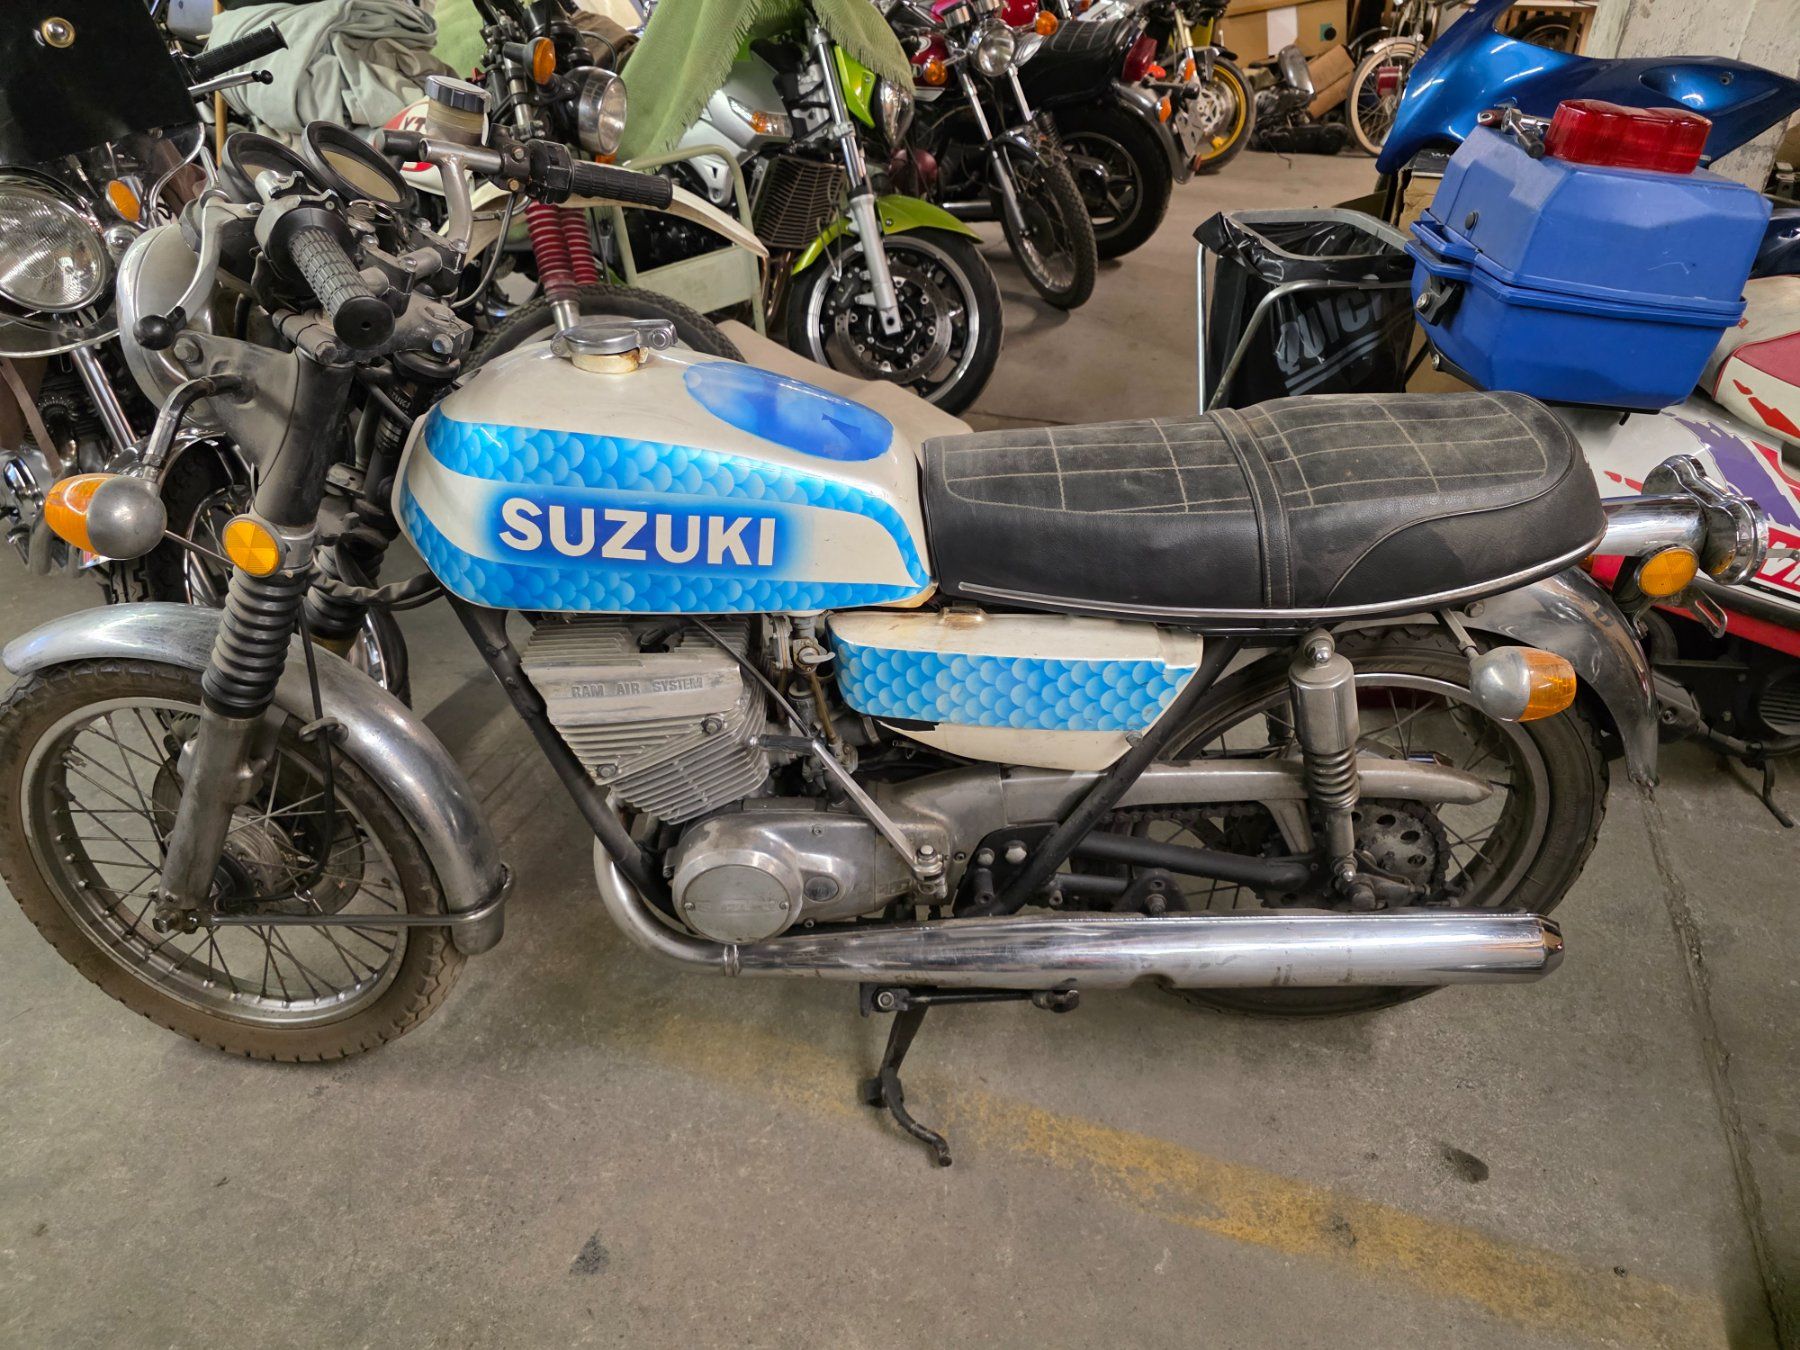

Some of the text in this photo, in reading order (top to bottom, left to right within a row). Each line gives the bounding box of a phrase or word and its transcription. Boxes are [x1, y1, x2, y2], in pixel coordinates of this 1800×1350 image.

[499, 497, 776, 566] SUZUKI
[572, 677, 703, 698] RAM AIR SYSTEM
